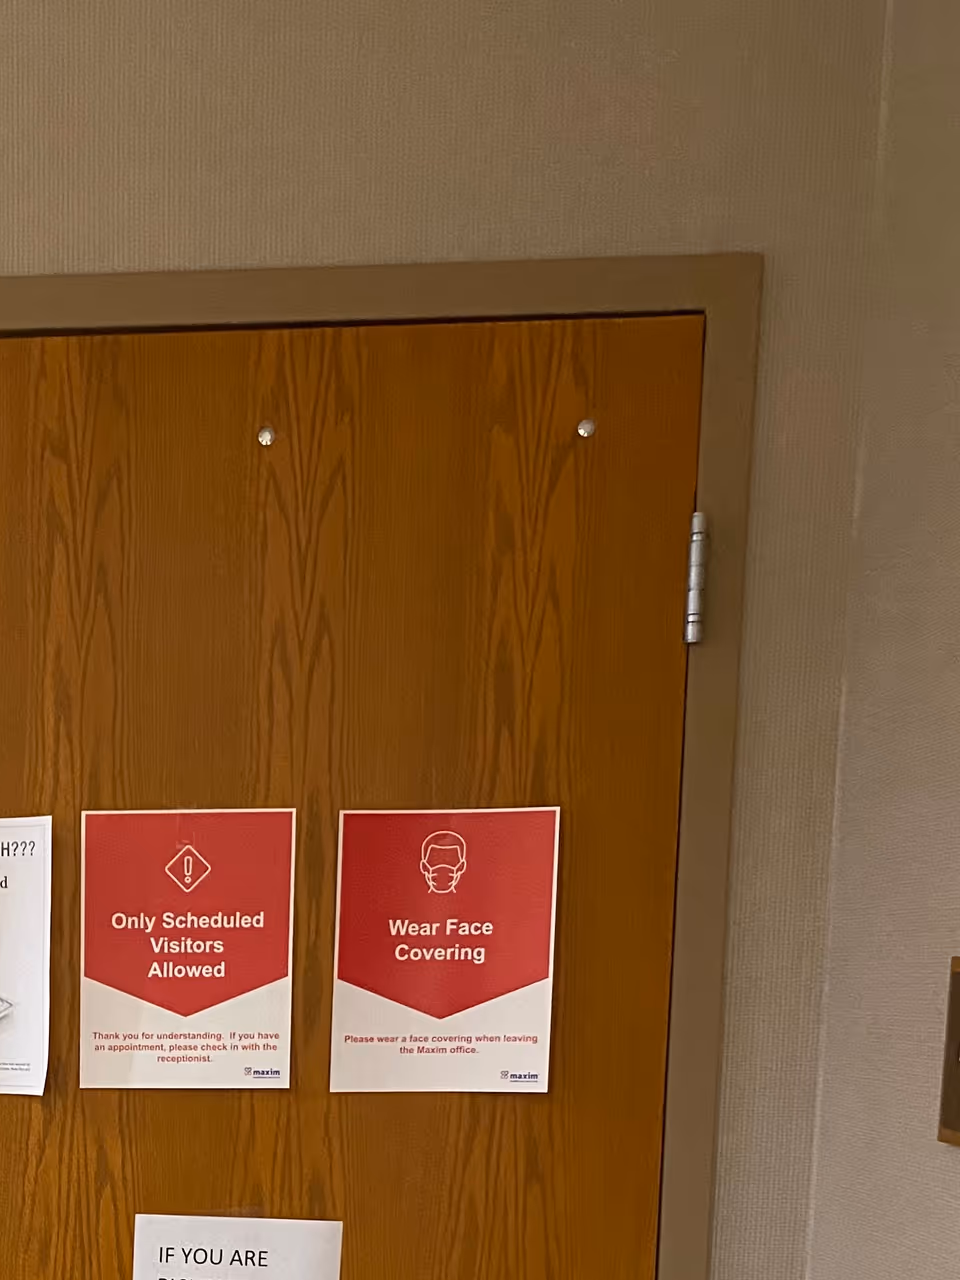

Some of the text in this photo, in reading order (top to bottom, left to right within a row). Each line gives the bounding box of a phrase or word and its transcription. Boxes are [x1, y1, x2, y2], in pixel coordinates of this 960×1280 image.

[111, 912, 264, 932] Only Scheduled
[388, 919, 493, 936] Wear Face
[150, 938, 224, 953] Visitors
[395, 944, 486, 964] Covering
[148, 962, 225, 978] Allowed
[122, 1033, 138, 1041] you
[156, 1032, 224, 1041] understanding.
[238, 1033, 255, 1041] you
[410, 1034, 429, 1042] face
[432, 1034, 472, 1044] covering
[475, 1034, 500, 1042] when
[504, 1034, 538, 1044] leaving
[108, 1044, 166, 1052] appointment,
[169, 1044, 198, 1052] please
[200, 1043, 227, 1051] check
[157, 1055, 212, 1064] receptionist.
[159, 1246, 269, 1267] IF YOU ARE
